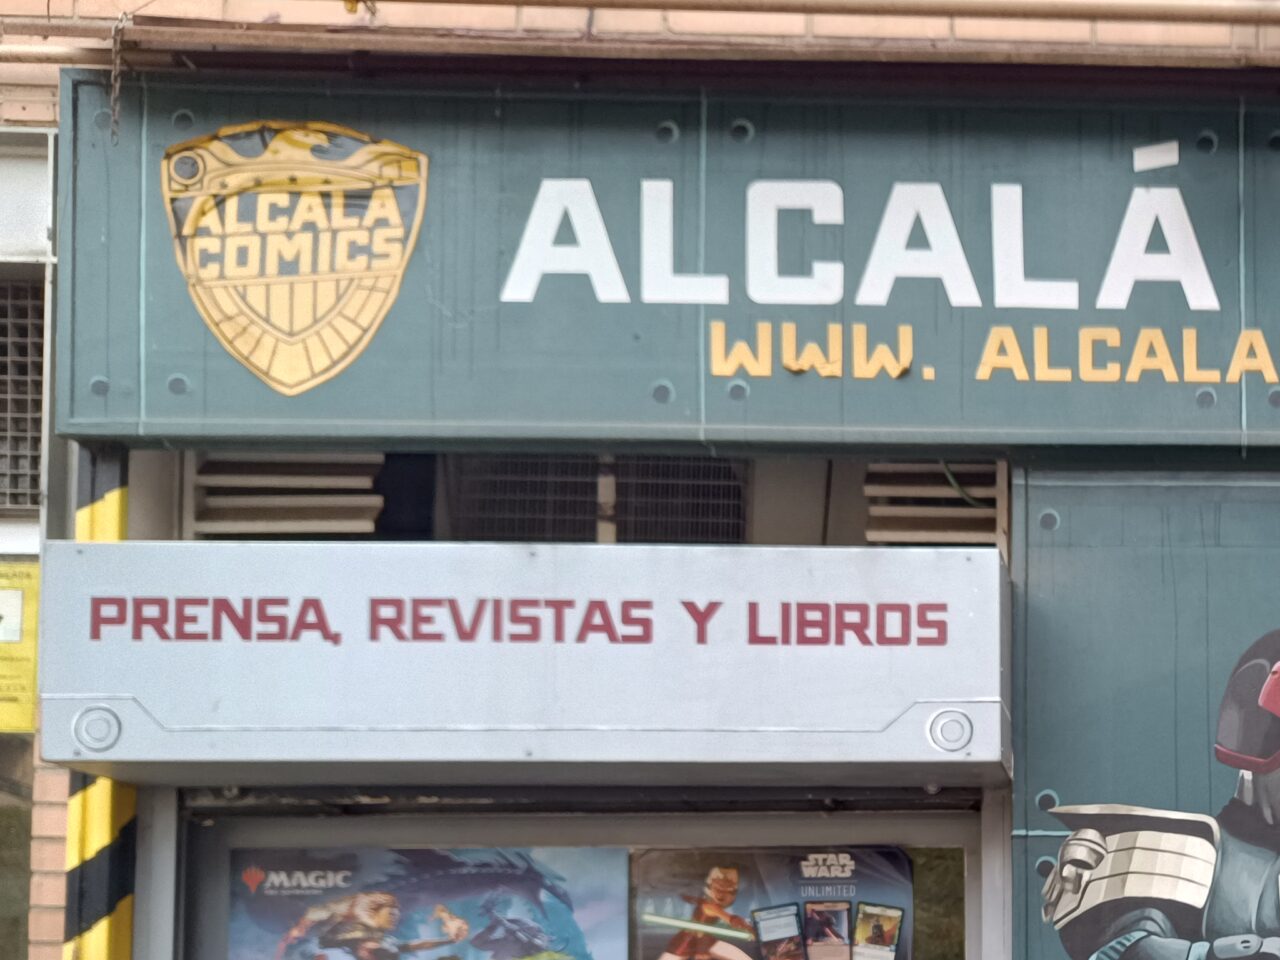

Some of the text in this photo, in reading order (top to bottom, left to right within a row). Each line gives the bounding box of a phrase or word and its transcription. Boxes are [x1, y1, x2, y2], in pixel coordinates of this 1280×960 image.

[182, 187, 404, 236] ALCALA
[500, 140, 1221, 311] ALCALÁ
[191, 226, 405, 280] COMICS
[90, 597, 949, 647] PRENSA, REVISTAS Y LIBROS
[800, 853, 855, 866] STAR
[801, 865, 855, 878] WARS
[264, 869, 353, 889] MAGIC
[800, 884, 857, 897] UNLIMITED
